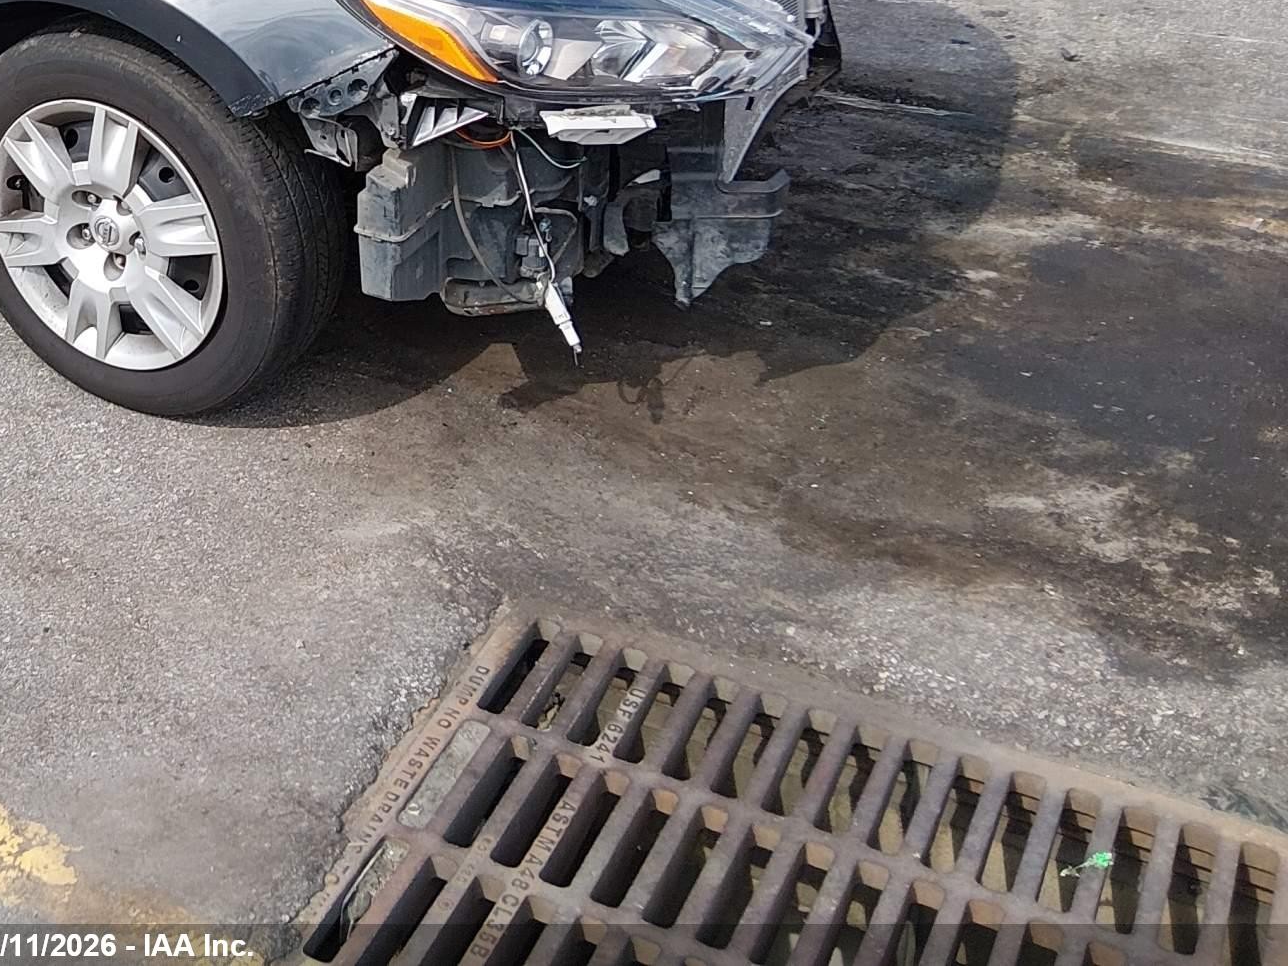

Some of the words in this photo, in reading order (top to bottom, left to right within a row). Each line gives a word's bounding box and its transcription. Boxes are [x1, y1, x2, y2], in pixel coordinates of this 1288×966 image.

[458, 665, 490, 706] DUMP
[616, 688, 647, 719] USF
[436, 708, 461, 729] NO
[394, 737, 440, 790] WASTE
[589, 723, 624, 765] 6241
[533, 801, 577, 853] ASTM
[511, 854, 543, 891] A48
